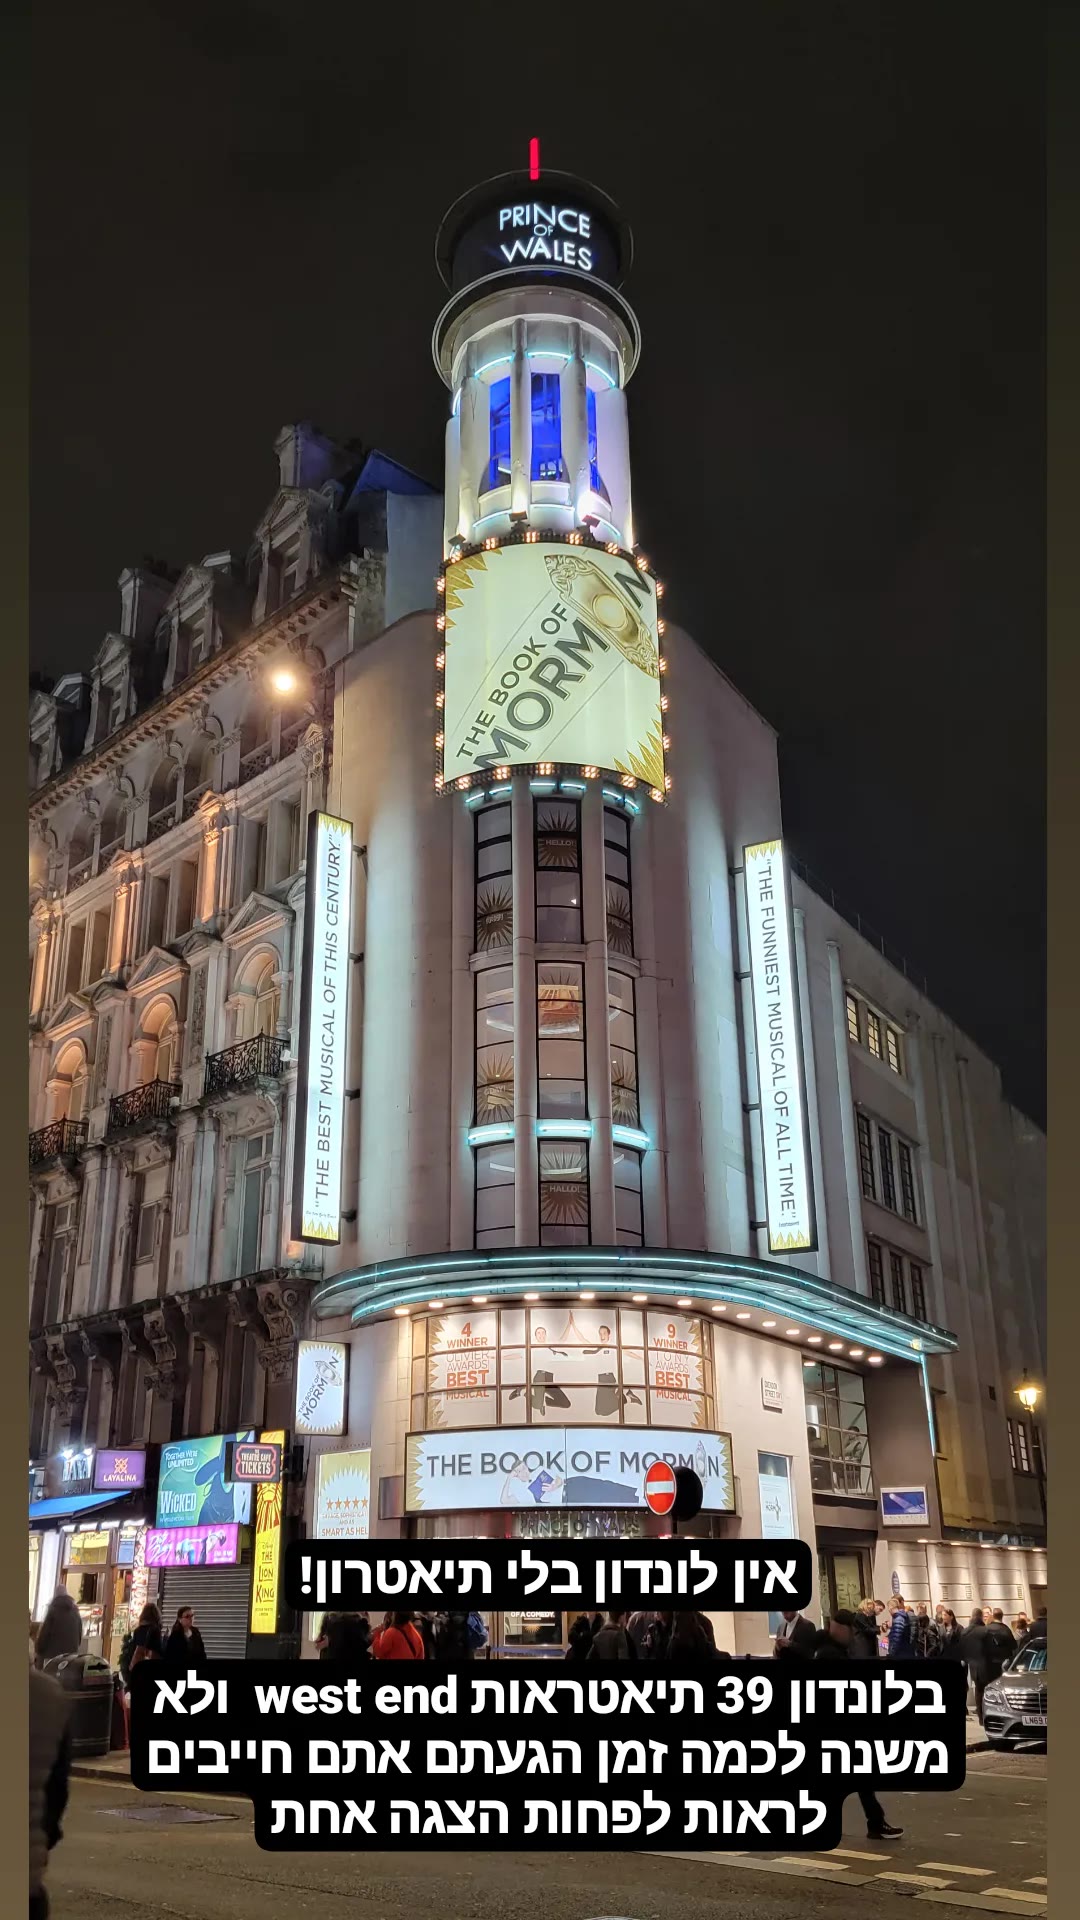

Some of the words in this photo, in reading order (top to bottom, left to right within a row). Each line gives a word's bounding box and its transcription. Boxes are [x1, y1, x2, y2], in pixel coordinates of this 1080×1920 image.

[499, 203, 591, 239] PRINCE
[533, 223, 554, 237] OF
[500, 236, 592, 271] WALES
[456, 709, 495, 759] THE
[488, 635, 547, 707] BOOK
[540, 602, 570, 636] OF
[324, 931, 338, 974] THIS
[760, 906, 781, 996] FUNNIEST
[323, 976, 337, 1004] OF
[320, 1008, 336, 1096] MUSICAL
[768, 1003, 787, 1087] MUSICAL
[774, 1090, 790, 1117] OF
[317, 1100, 332, 1153] BEST
[776, 1122, 792, 1161] ALL
[461, 1321, 472, 1338] 4
[667, 1323, 676, 1339] 9
[447, 1337, 488, 1349] WINNER
[653, 1337, 688, 1350] WINNER
[447, 1360, 488, 1372] AWARDS
[655, 1361, 689, 1374] AWARDS
[446, 1369, 490, 1389] BEST
[655, 1371, 690, 1389] BEST
[446, 1388, 490, 1401] MUSICAL
[656, 1389, 692, 1402] MUSICAL
[241, 1461, 271, 1475] TICKETS
[427, 1453, 472, 1478] THE
[480, 1450, 564, 1475] BOOK
[570, 1450, 612, 1473] OF
[103, 1474, 137, 1482] LAYALINA
[321, 1527, 344, 1537] SMART
[345, 1527, 355, 1536] AS
[262, 1551, 273, 1561] THE
[259, 1565, 273, 1582] LION
[256, 1584, 275, 1604] KING
